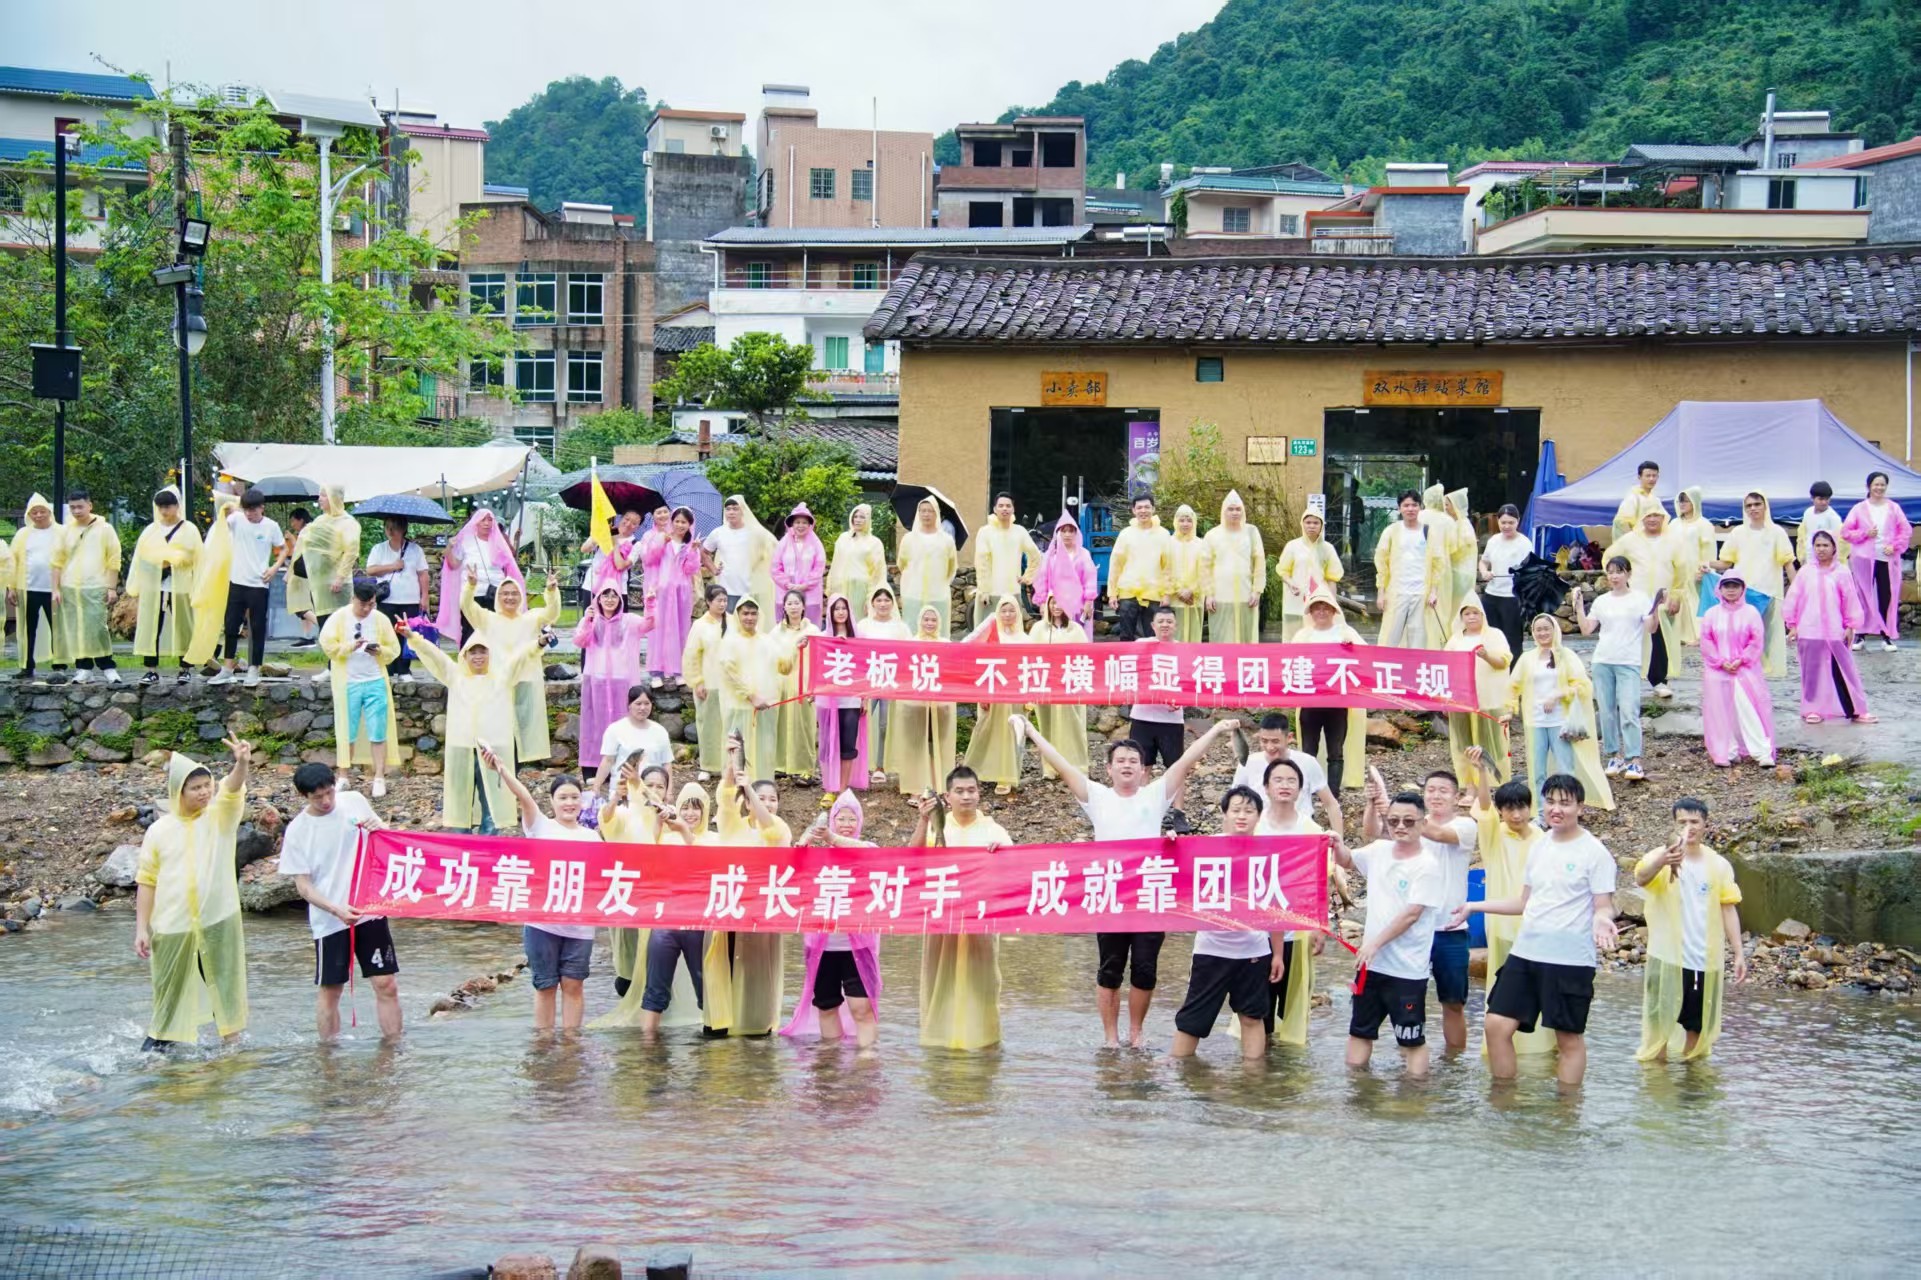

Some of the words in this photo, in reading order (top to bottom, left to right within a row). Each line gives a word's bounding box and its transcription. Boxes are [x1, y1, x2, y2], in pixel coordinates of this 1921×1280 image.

[1046, 379, 1101, 400] 小卖部
[823, 648, 944, 692] 老板说
[975, 653, 1453, 699] 不拉横幅显得团建不正规
